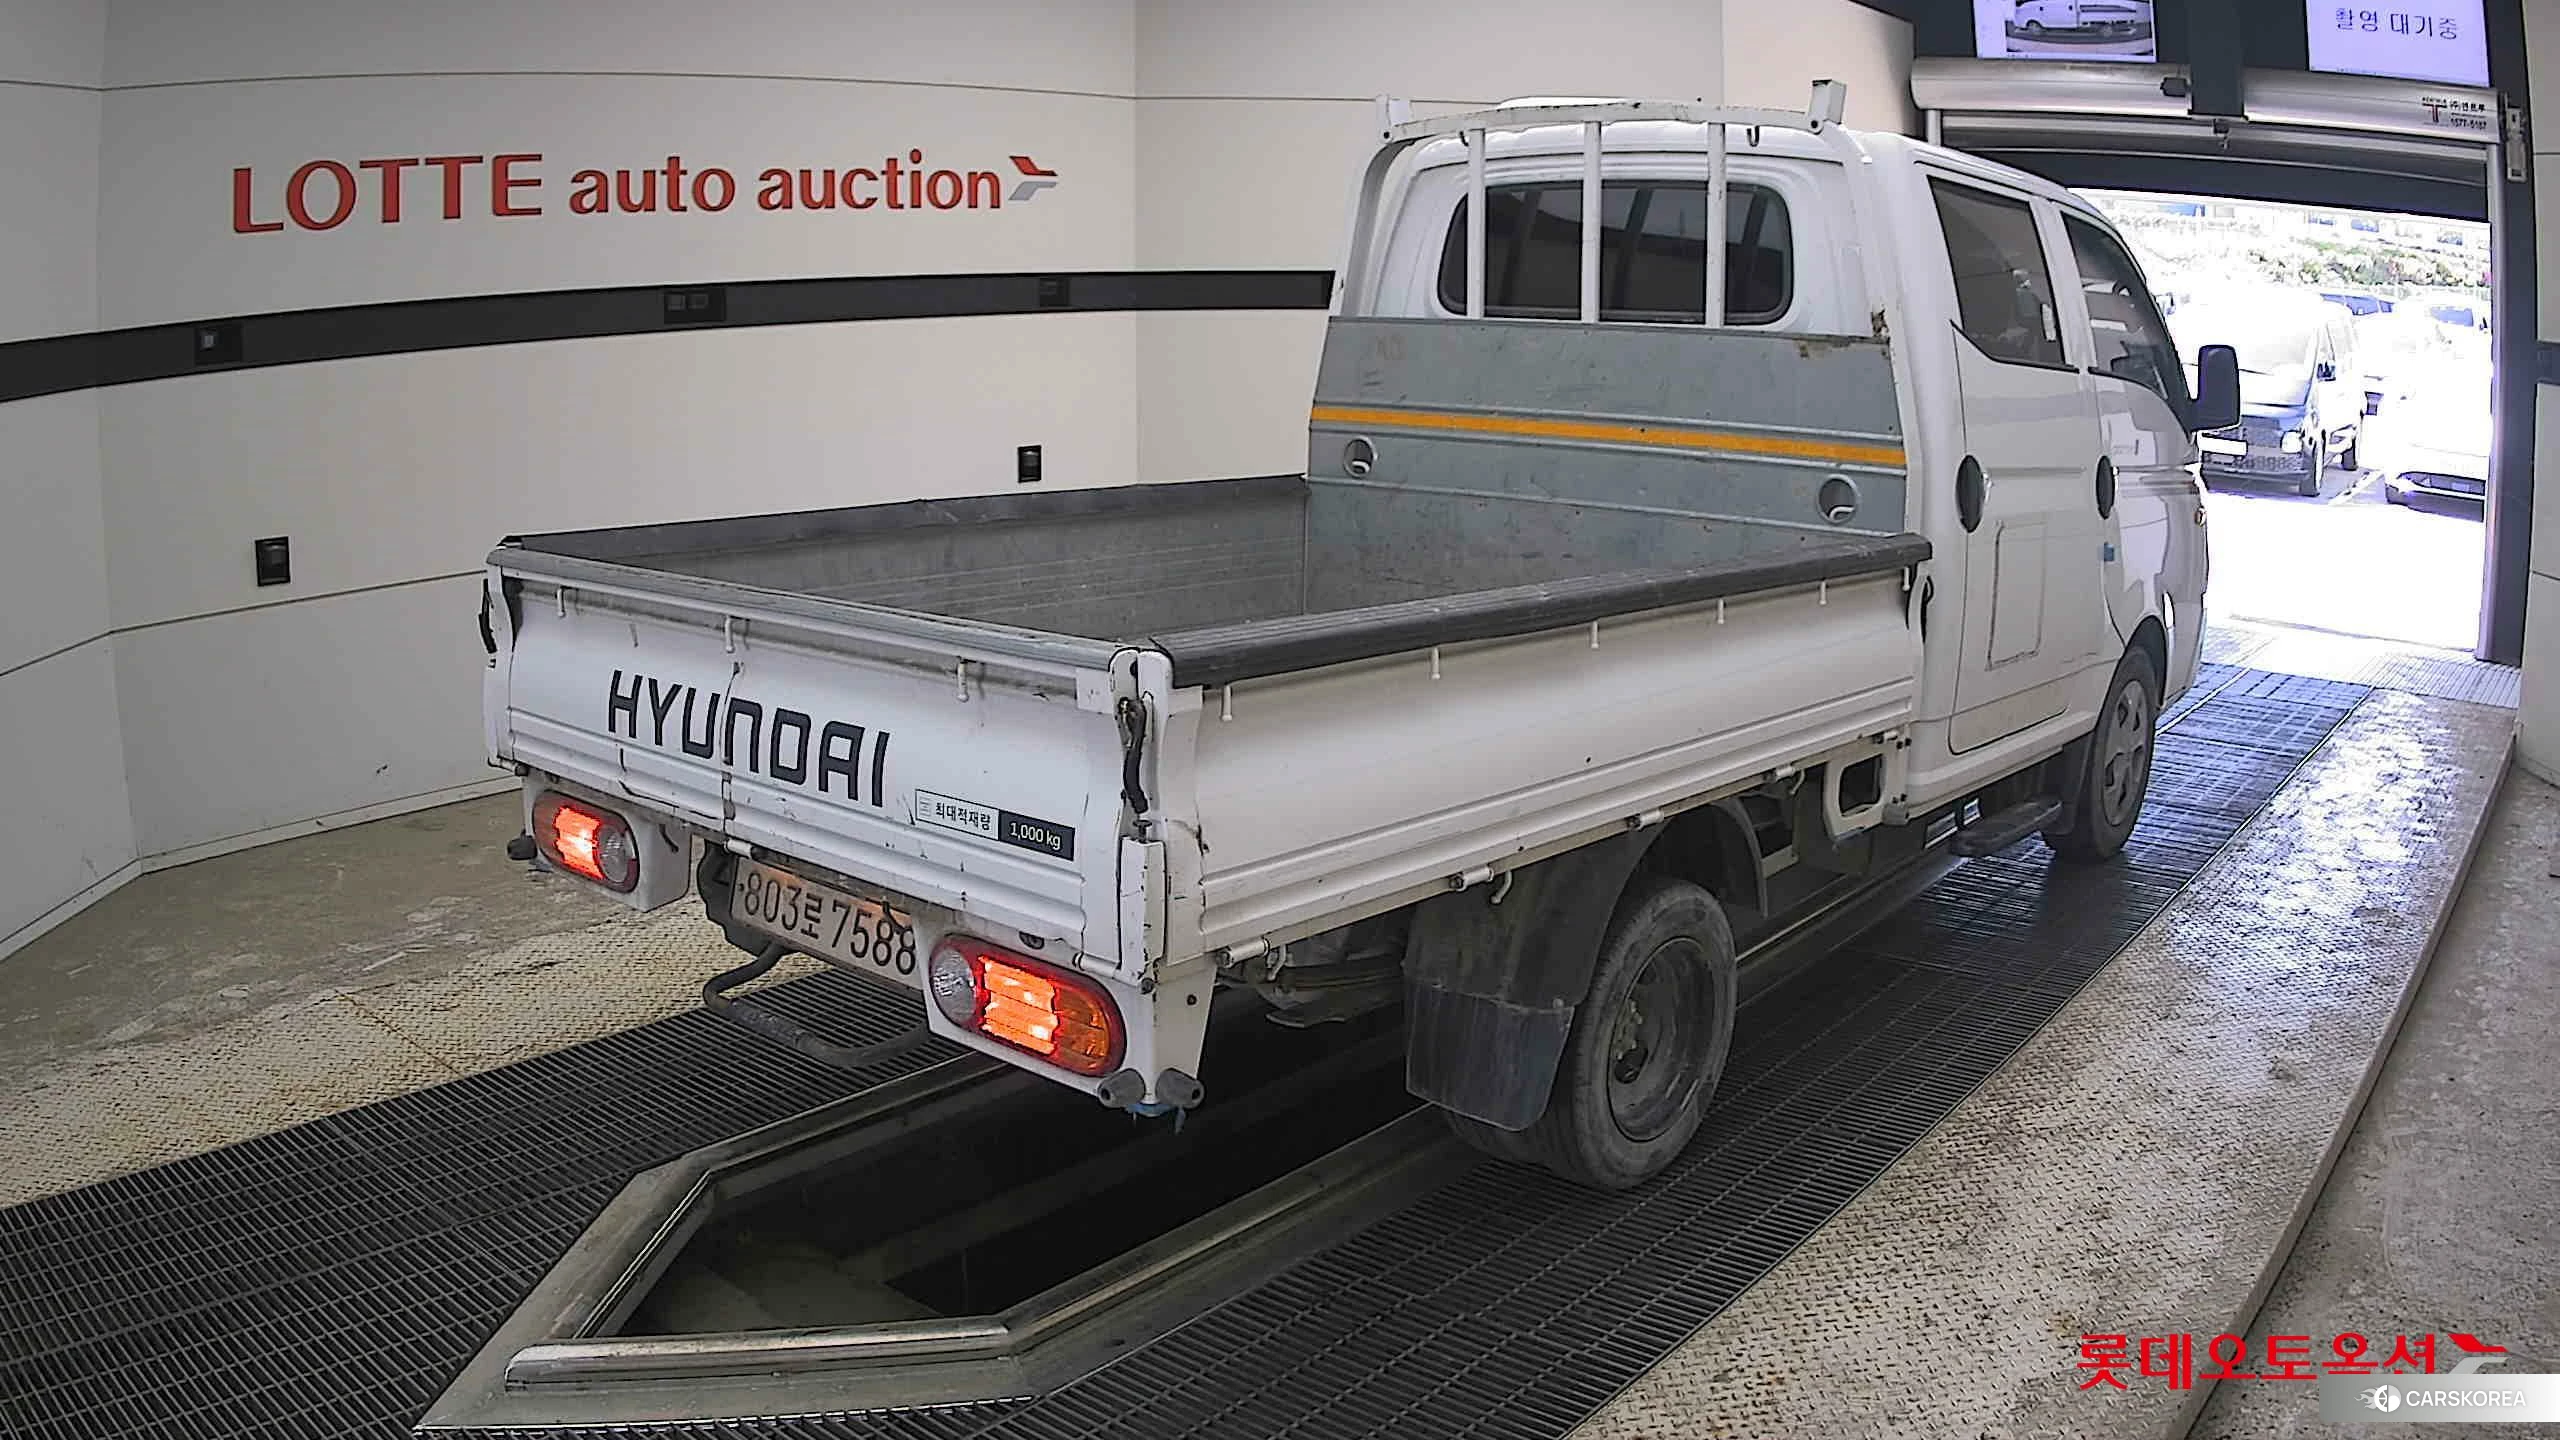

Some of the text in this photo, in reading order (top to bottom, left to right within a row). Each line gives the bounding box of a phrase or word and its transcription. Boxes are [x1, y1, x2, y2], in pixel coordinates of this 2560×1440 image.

[2335, 7, 2457, 40] 촬영 대기중
[233, 148, 1002, 234] LOTTE auto auction
[608, 670, 891, 808] HYUNDAI
[935, 801, 991, 832] 최대적재량
[1009, 822, 1044, 843] 1,000
[1046, 832, 1061, 850] kg
